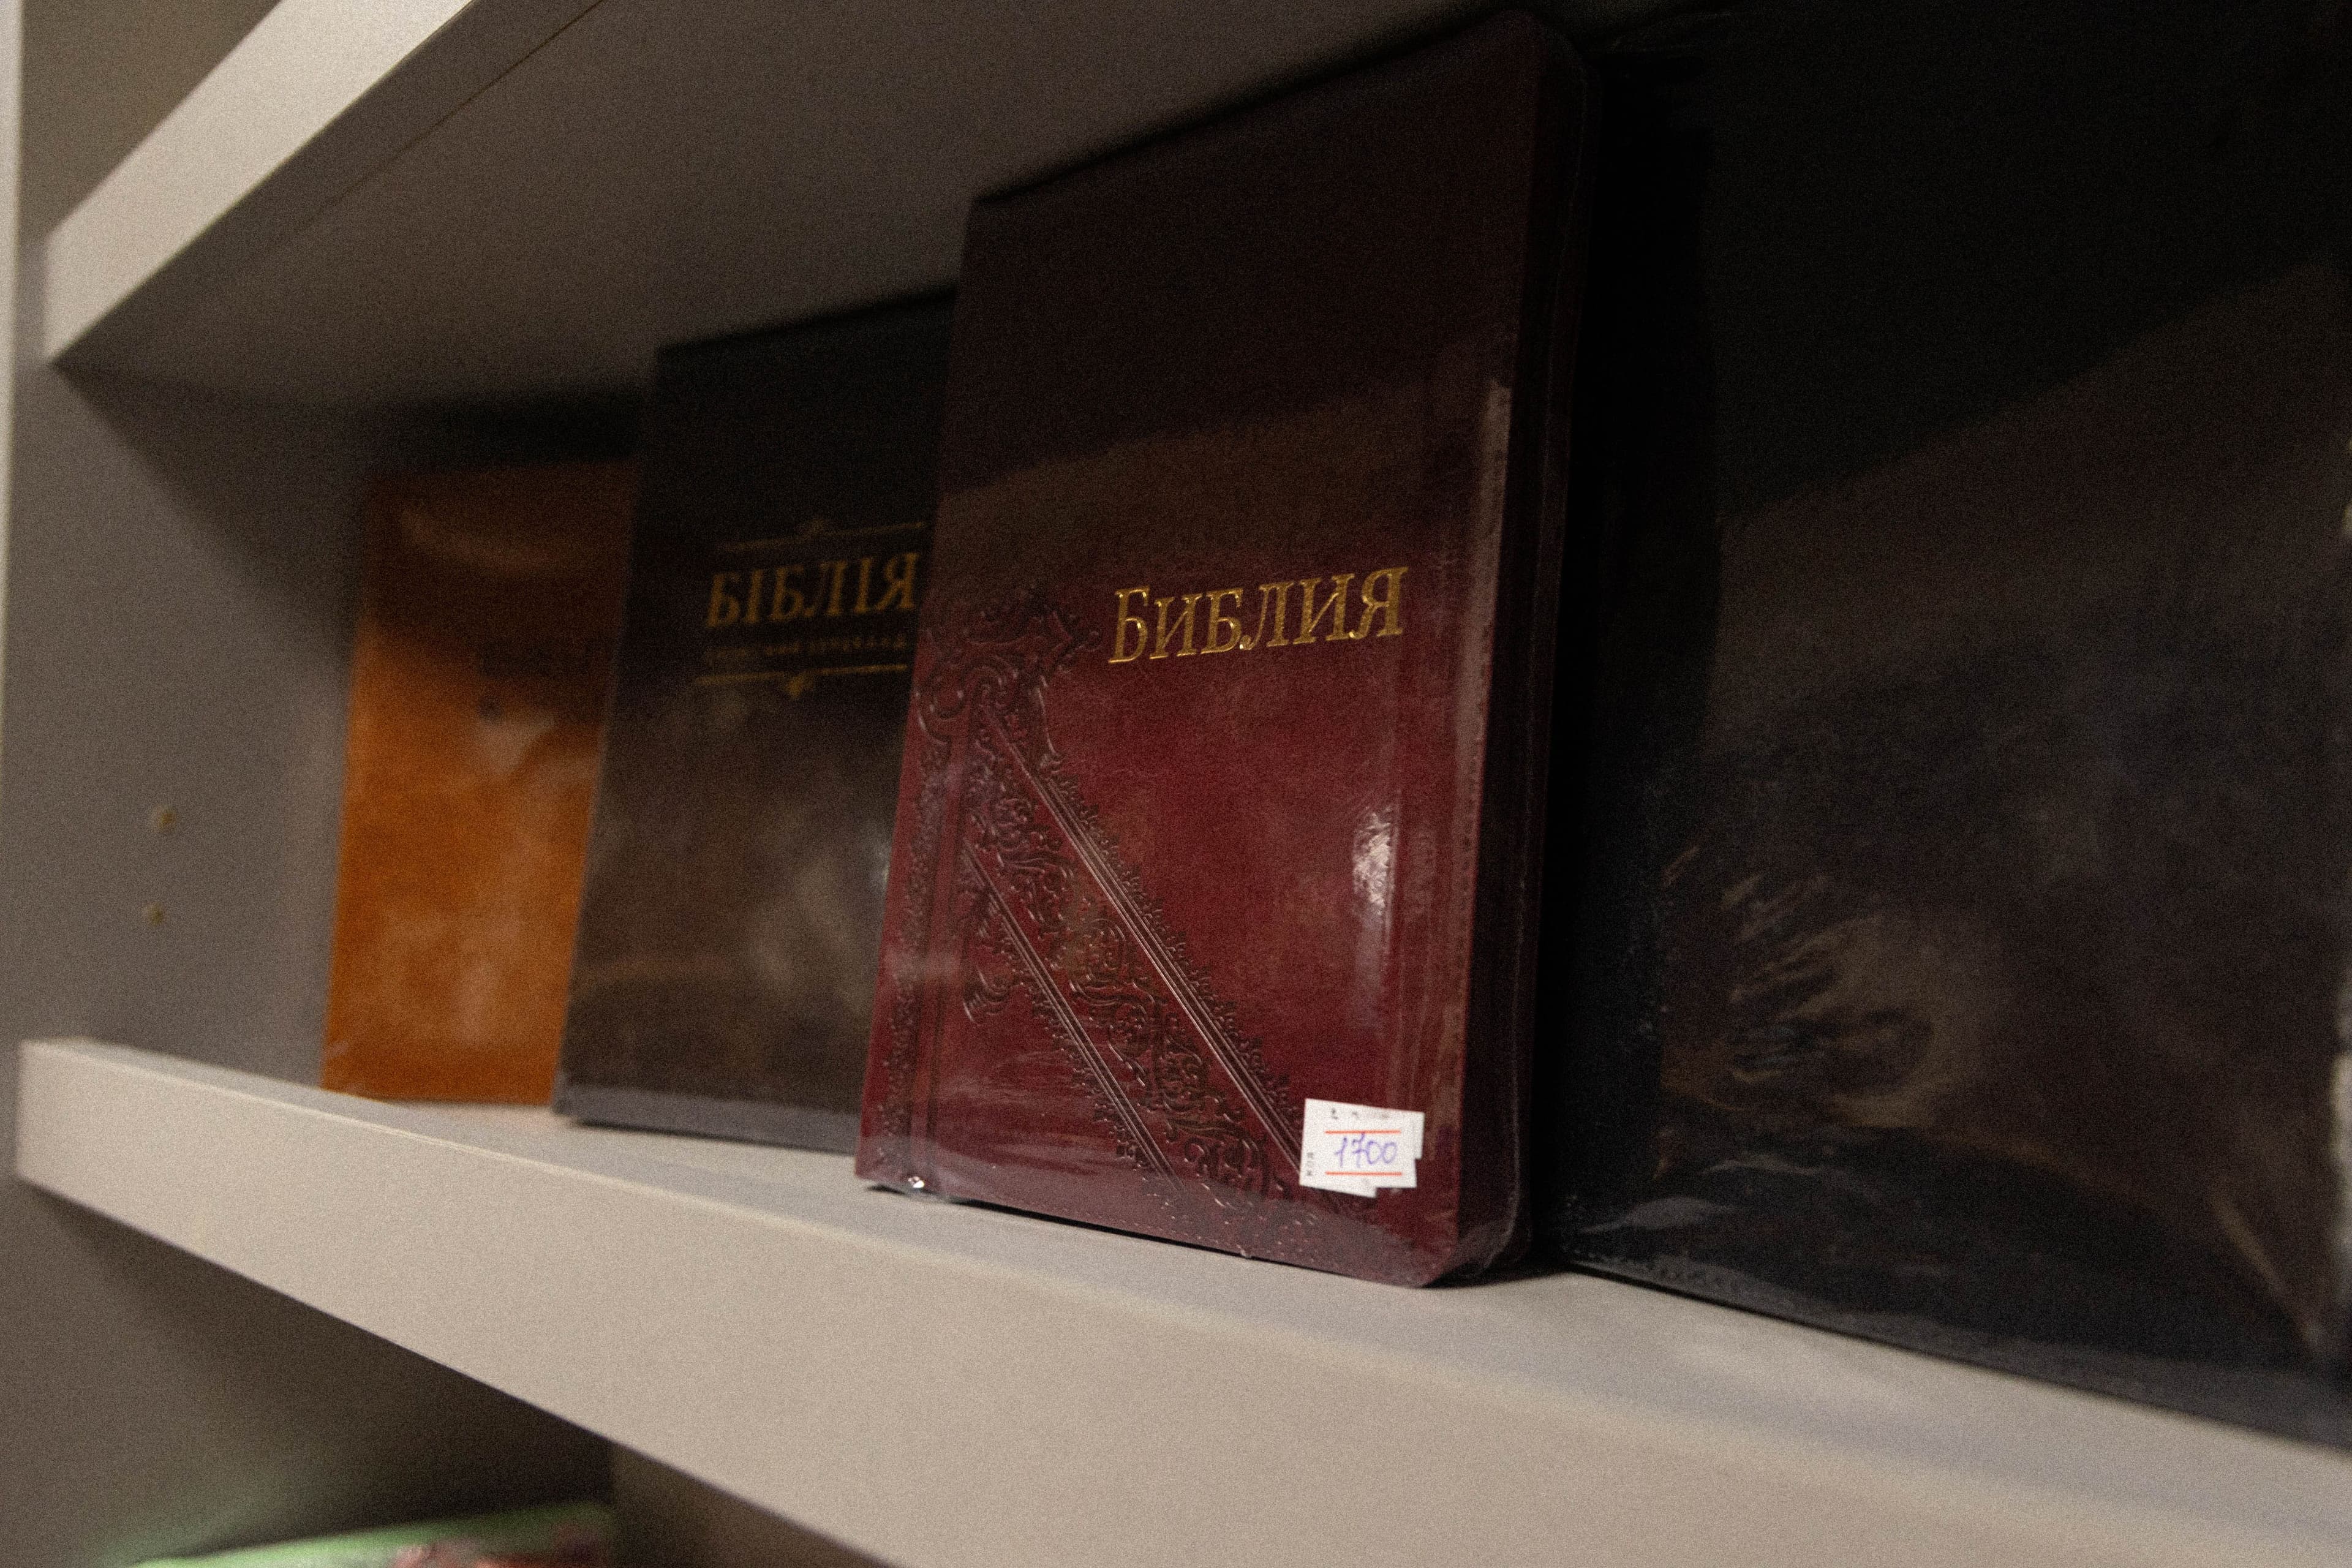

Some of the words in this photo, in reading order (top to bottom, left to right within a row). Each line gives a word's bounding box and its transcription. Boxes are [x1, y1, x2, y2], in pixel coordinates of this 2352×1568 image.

[706, 552, 919, 629] БІБЛІЯ
[1107, 567, 1409, 664] БИБЛИЯ
[1333, 1132, 1397, 1169] 1700
